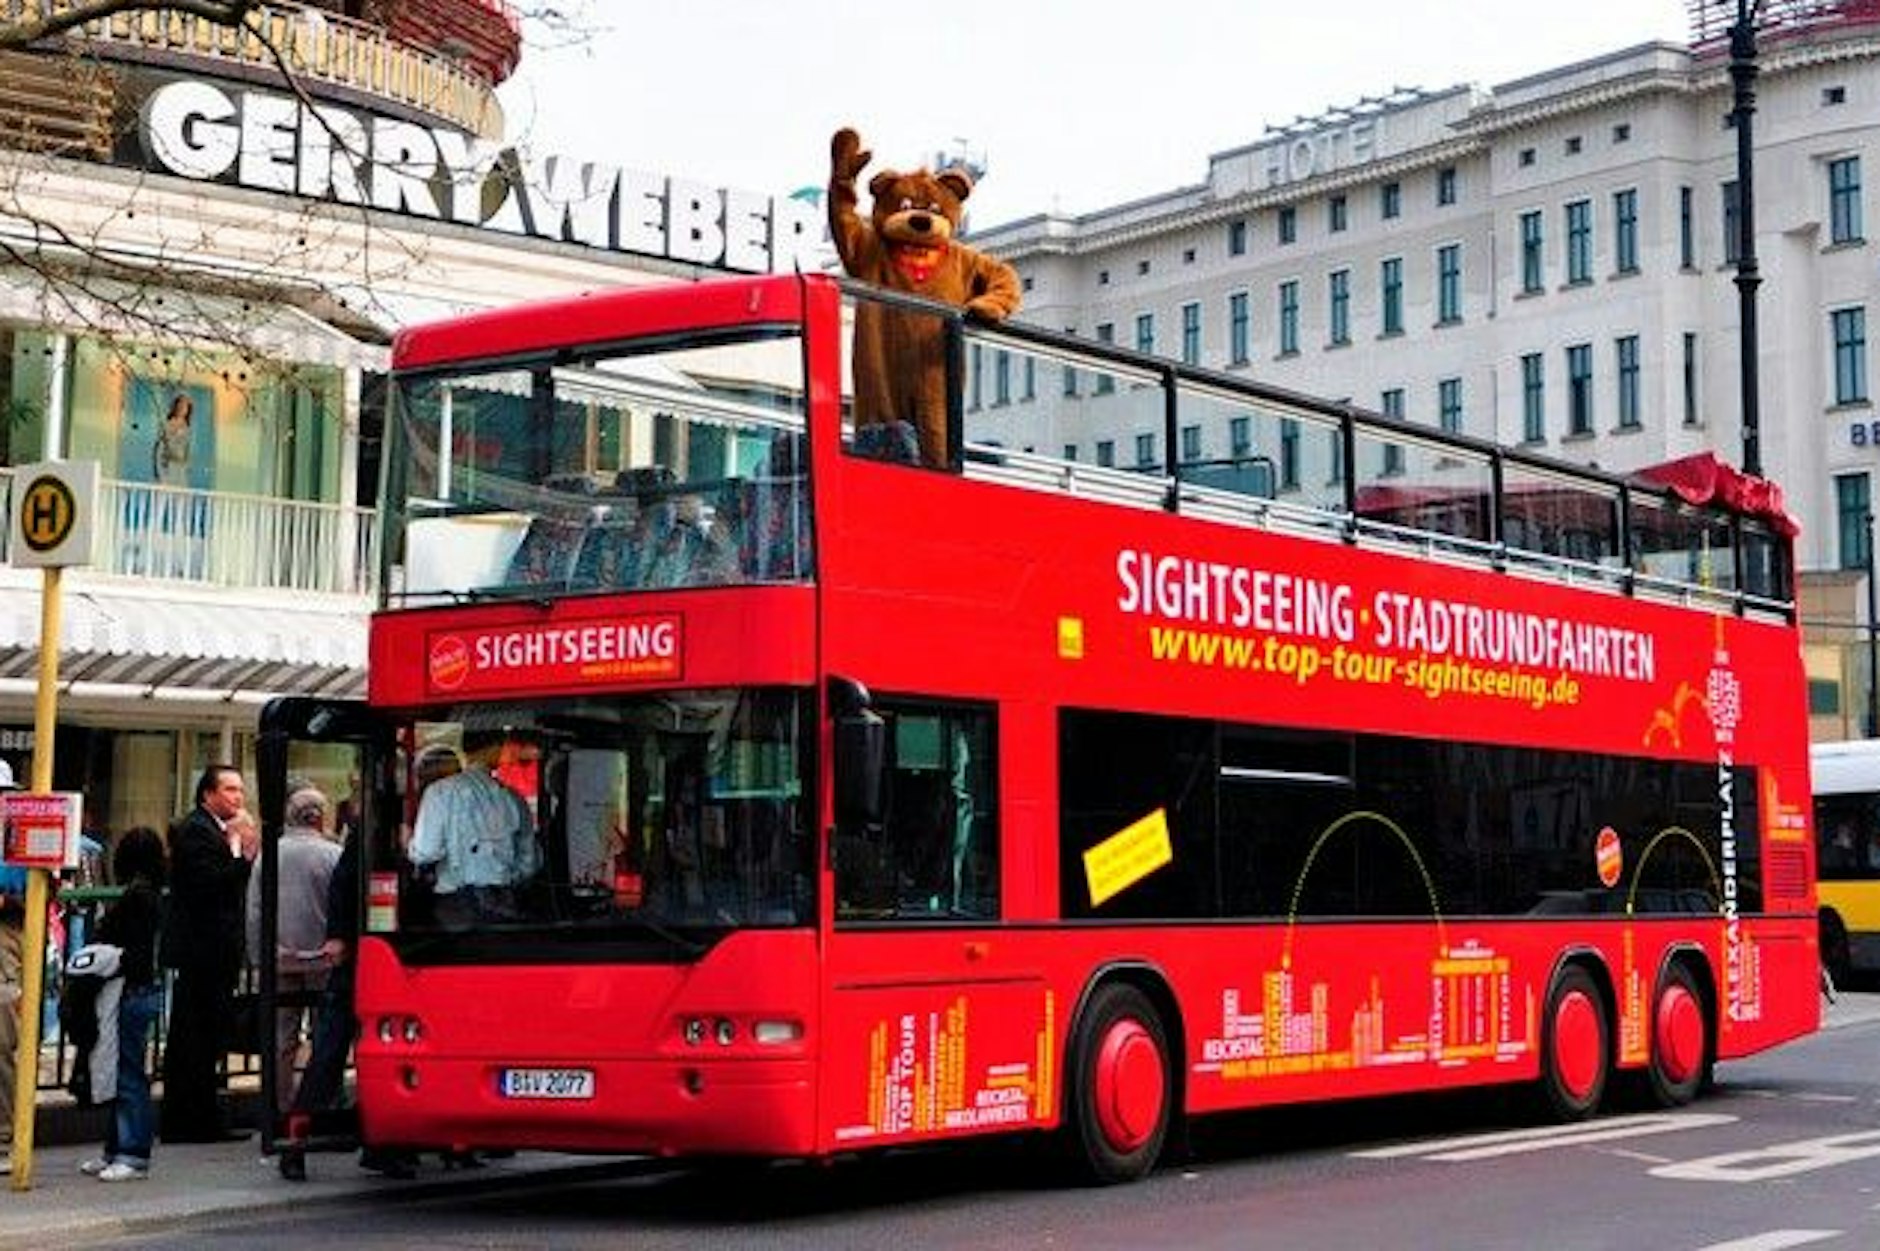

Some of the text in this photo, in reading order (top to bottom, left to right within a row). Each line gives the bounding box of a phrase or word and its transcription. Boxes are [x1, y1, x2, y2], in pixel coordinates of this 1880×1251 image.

[146, 80, 834, 276] GERRY WEBER
[33, 493, 57, 534] H
[475, 622, 675, 669] SIGHTSEEING
[1116, 549, 1354, 642] SIGHTSEEING
[1374, 591, 1655, 682] STADTRUNDFAHRTEN
[1150, 626, 1580, 709] www.top-tour-sightseeing.de
[1718, 749, 1741, 1021] ALEXANDERPLATZ
[898, 1014, 916, 1129] TOP TOUR
